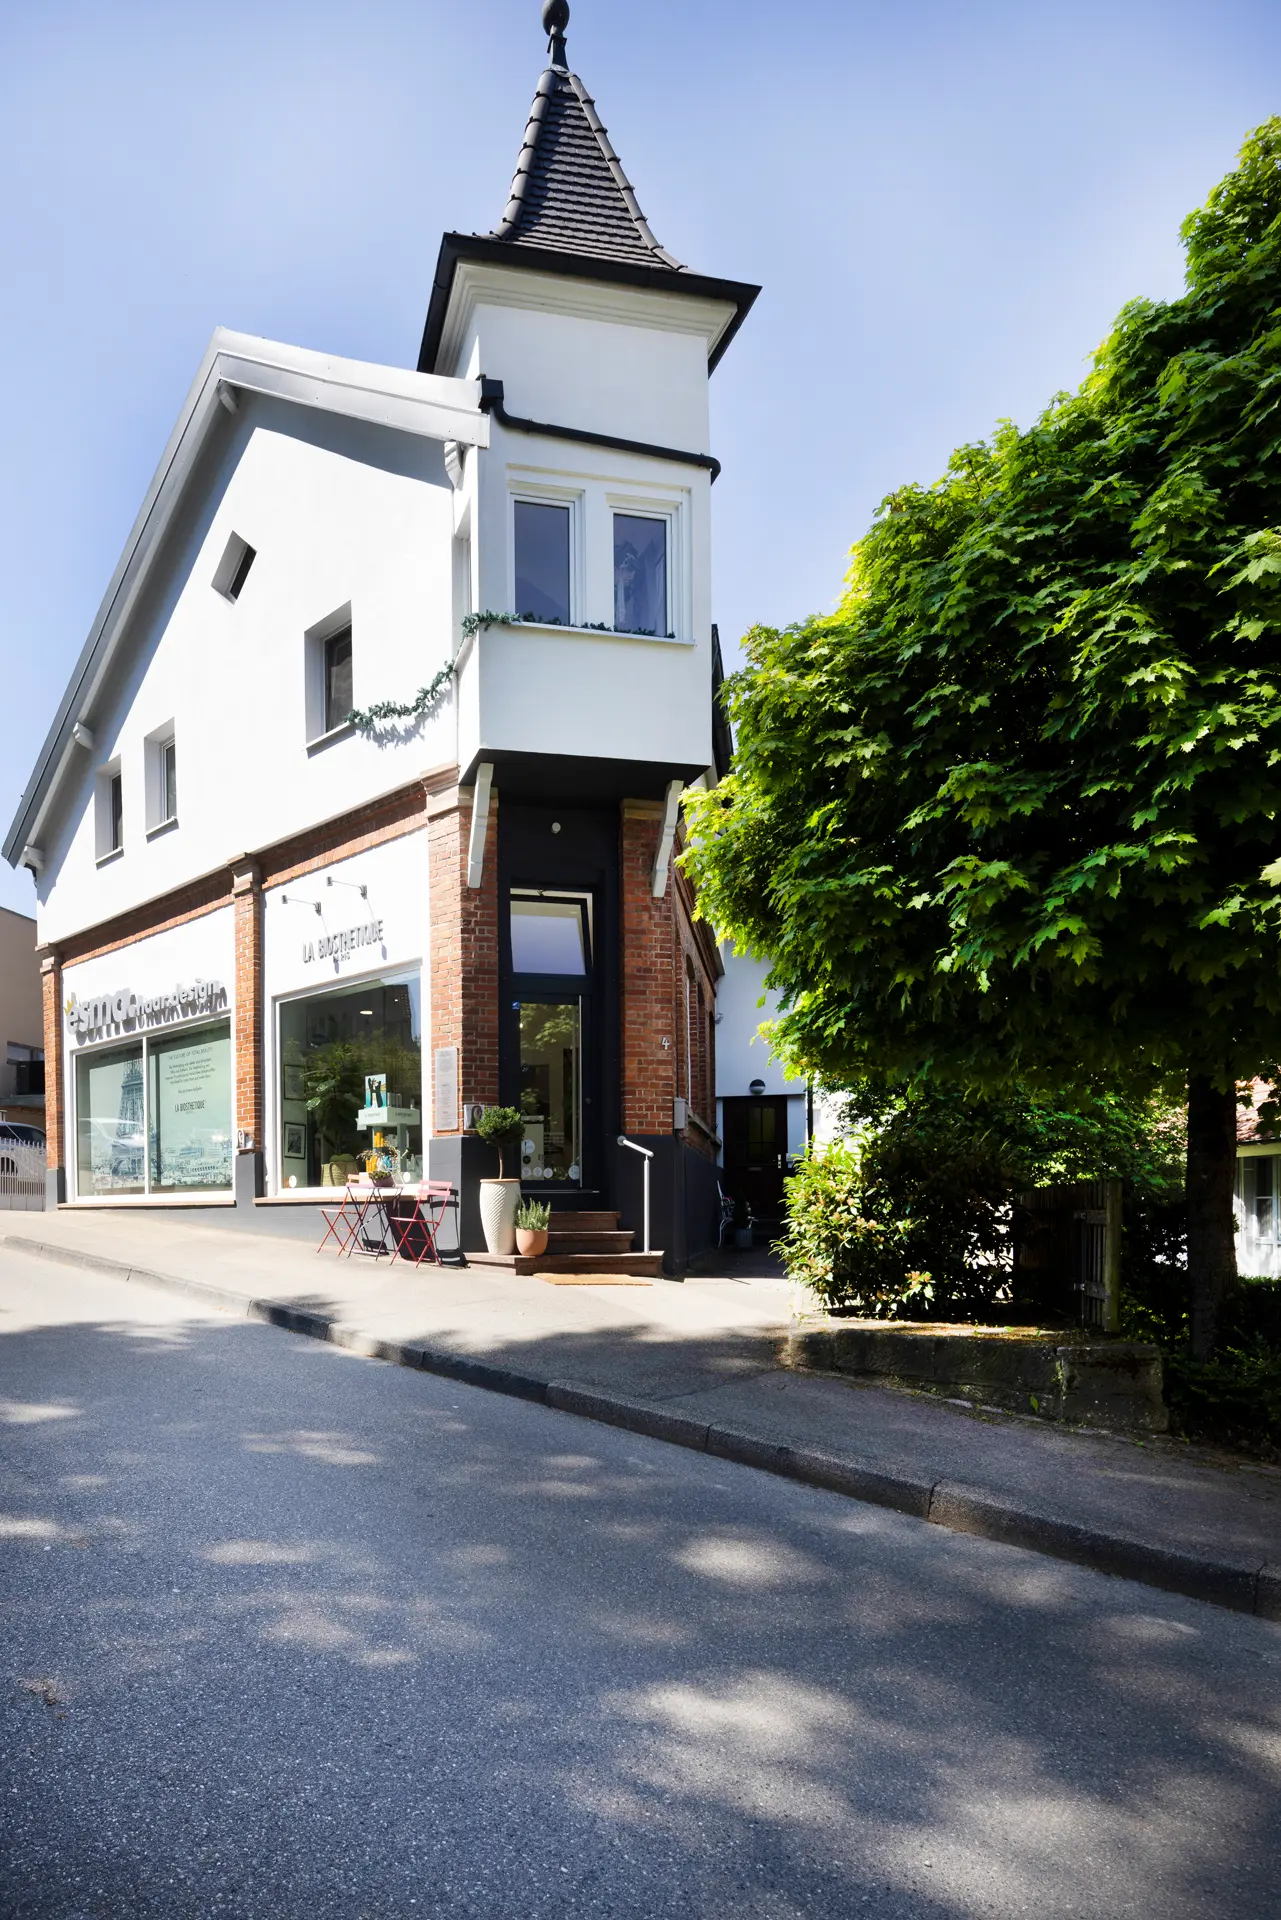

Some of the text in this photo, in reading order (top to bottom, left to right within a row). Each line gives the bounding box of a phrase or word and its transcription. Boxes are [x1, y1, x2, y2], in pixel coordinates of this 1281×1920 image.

[303, 919, 383, 964] LA BIOSTHETIQUE
[662, 1037, 670, 1050] 4
[174, 1104, 180, 1113] LA
